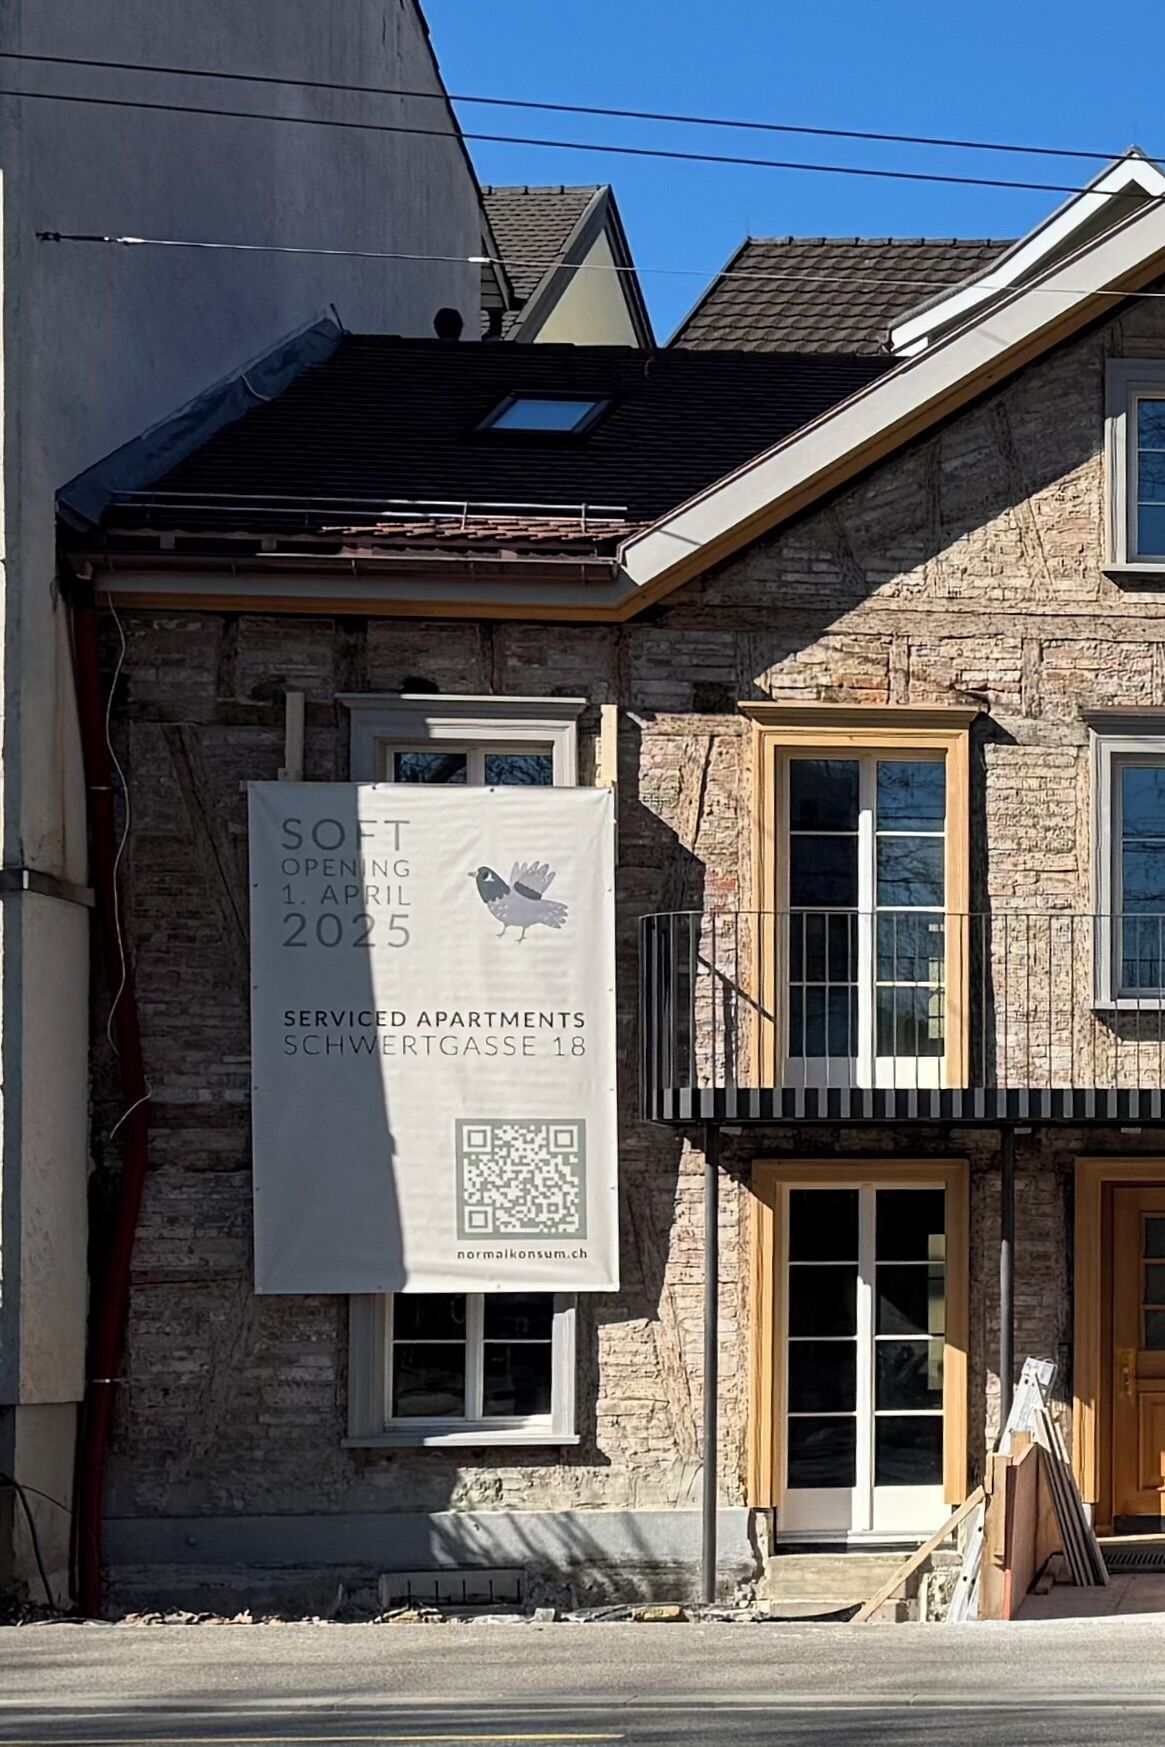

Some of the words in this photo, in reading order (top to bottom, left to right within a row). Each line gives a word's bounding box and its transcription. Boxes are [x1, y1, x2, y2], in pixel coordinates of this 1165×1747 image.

[281, 818, 411, 851] SOFT
[281, 858, 410, 878] OPENING
[283, 884, 306, 905] 1.
[321, 884, 411, 906] APRIL
[282, 913, 411, 948] 2025
[284, 1010, 407, 1027] SERVICED
[416, 1011, 586, 1028] APARTMENTS
[284, 1035, 537, 1056] SCHWERTGASSE
[552, 1036, 586, 1057] 18
[456, 1247, 588, 1259] normalkonsum.ch
